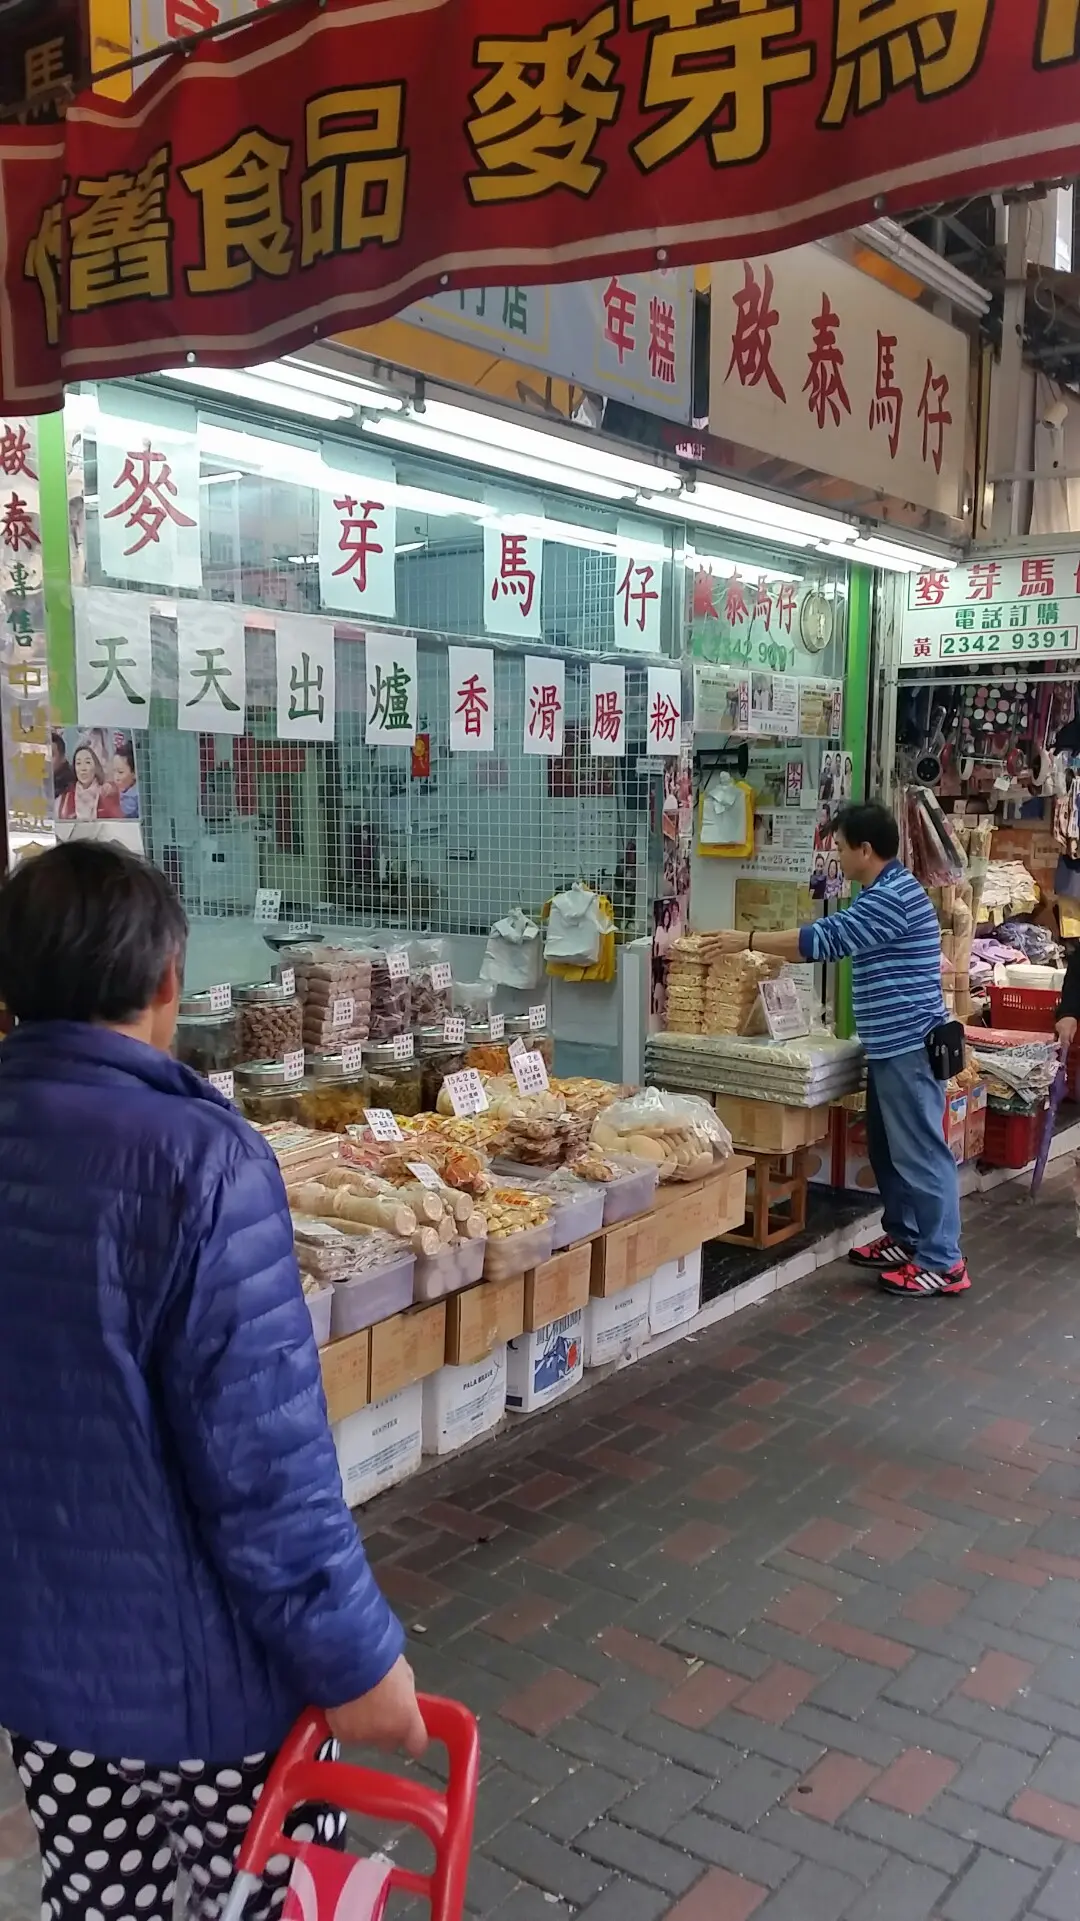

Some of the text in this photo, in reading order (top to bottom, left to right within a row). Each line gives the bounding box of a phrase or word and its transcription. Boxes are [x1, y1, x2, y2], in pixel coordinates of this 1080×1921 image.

[463, 0, 1080, 206] 麥芽馬
[603, 275, 676, 384] 年糕
[103, 440, 659, 632] 麥芽馬仔
[915, 558, 1080, 607] 麥芽馬
[955, 602, 1060, 630] 電話訂購
[914, 630, 1070, 658] 黃 2342 9391
